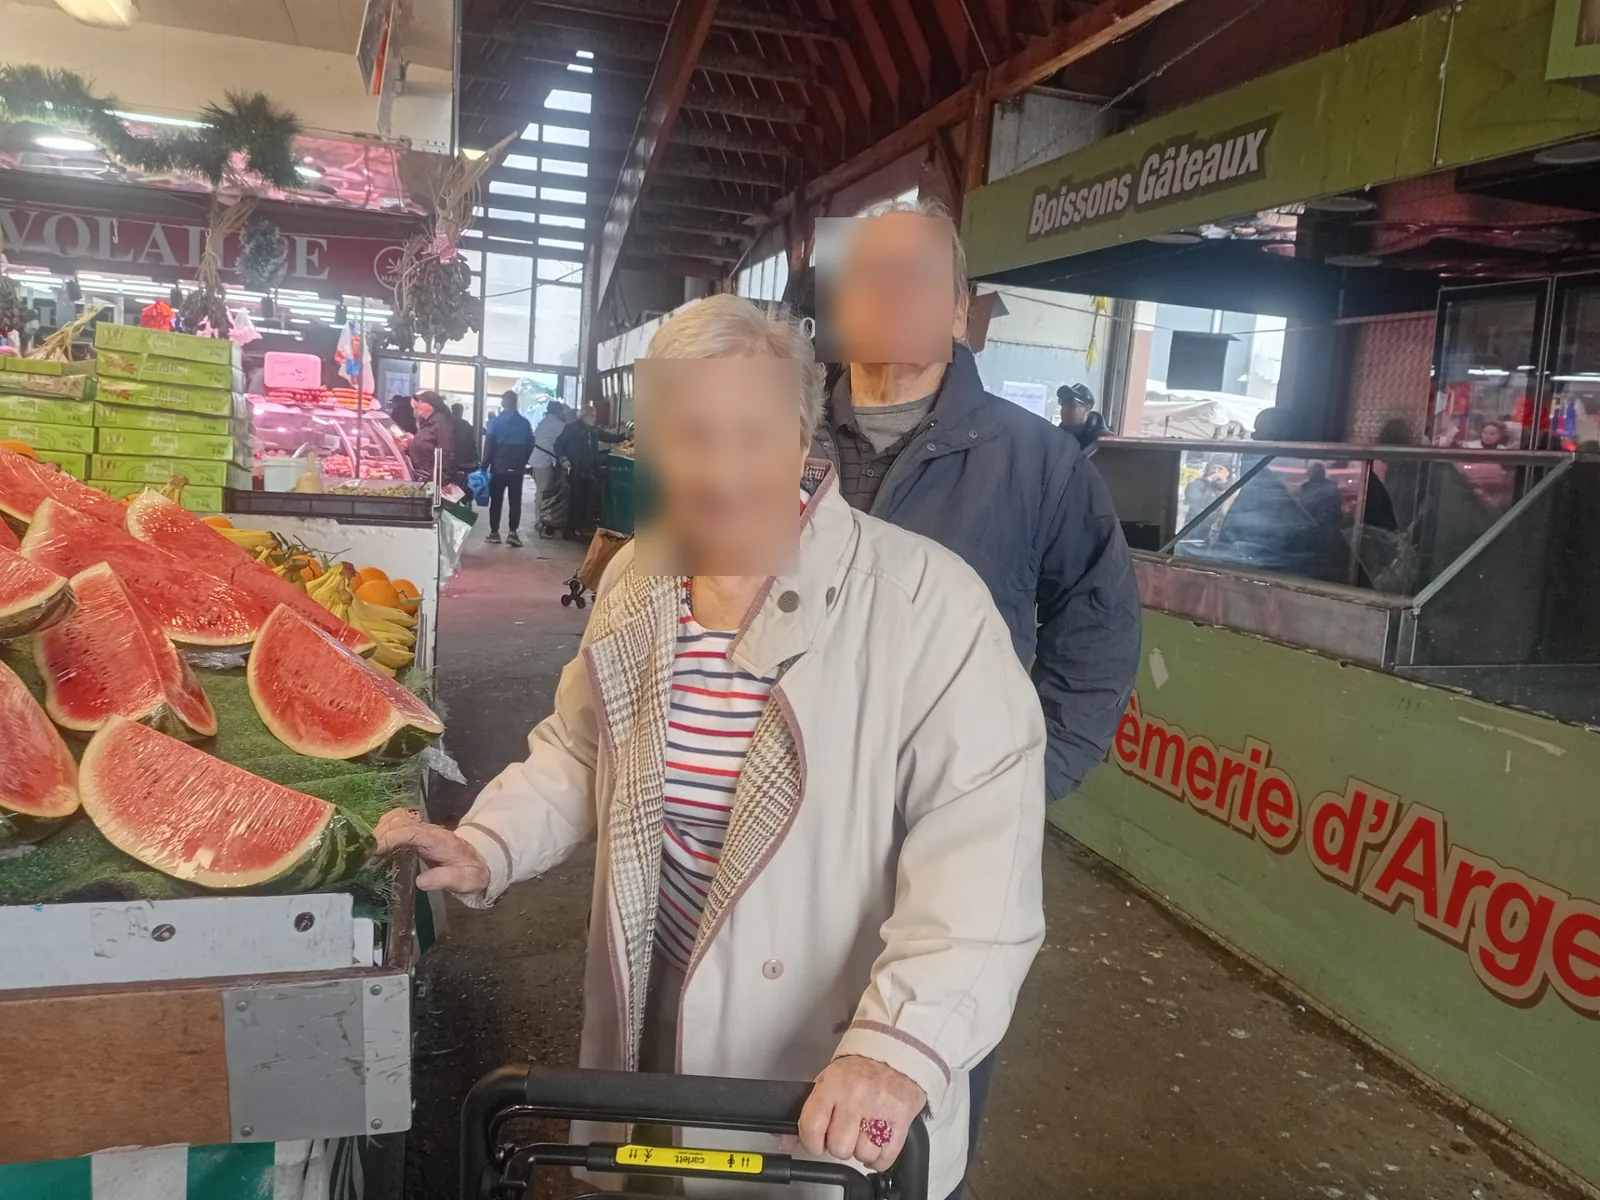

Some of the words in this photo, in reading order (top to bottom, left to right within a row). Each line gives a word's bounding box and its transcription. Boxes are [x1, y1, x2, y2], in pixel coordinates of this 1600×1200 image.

[1028, 172, 1133, 235] Boissons
[1137, 128, 1267, 205] Gâteaux
[0, 208, 330, 280] VOLAILE
[1115, 695, 1294, 838] èmerie
[674, 1155, 705, 1165] carlett
